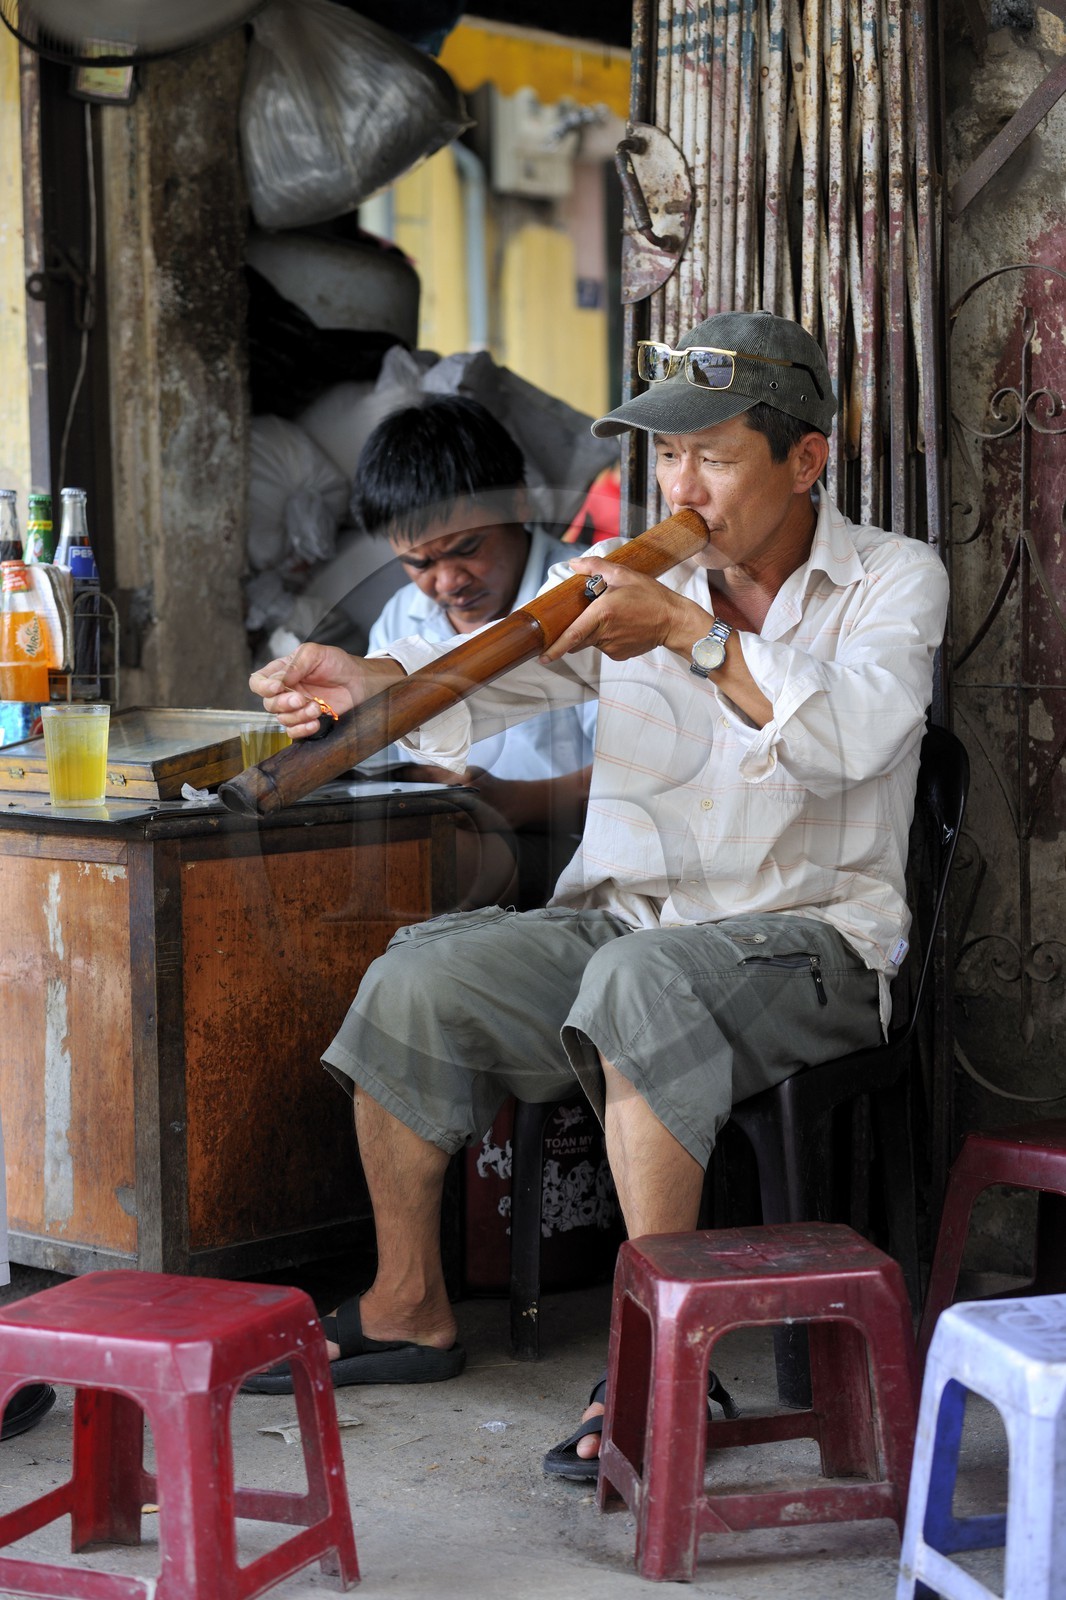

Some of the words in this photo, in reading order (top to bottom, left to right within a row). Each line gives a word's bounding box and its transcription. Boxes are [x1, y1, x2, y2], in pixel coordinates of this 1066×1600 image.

[545, 1137, 577, 1149] TOAN
[579, 1135, 593, 1146] MY
[552, 1147, 589, 1155] PLASTIC
